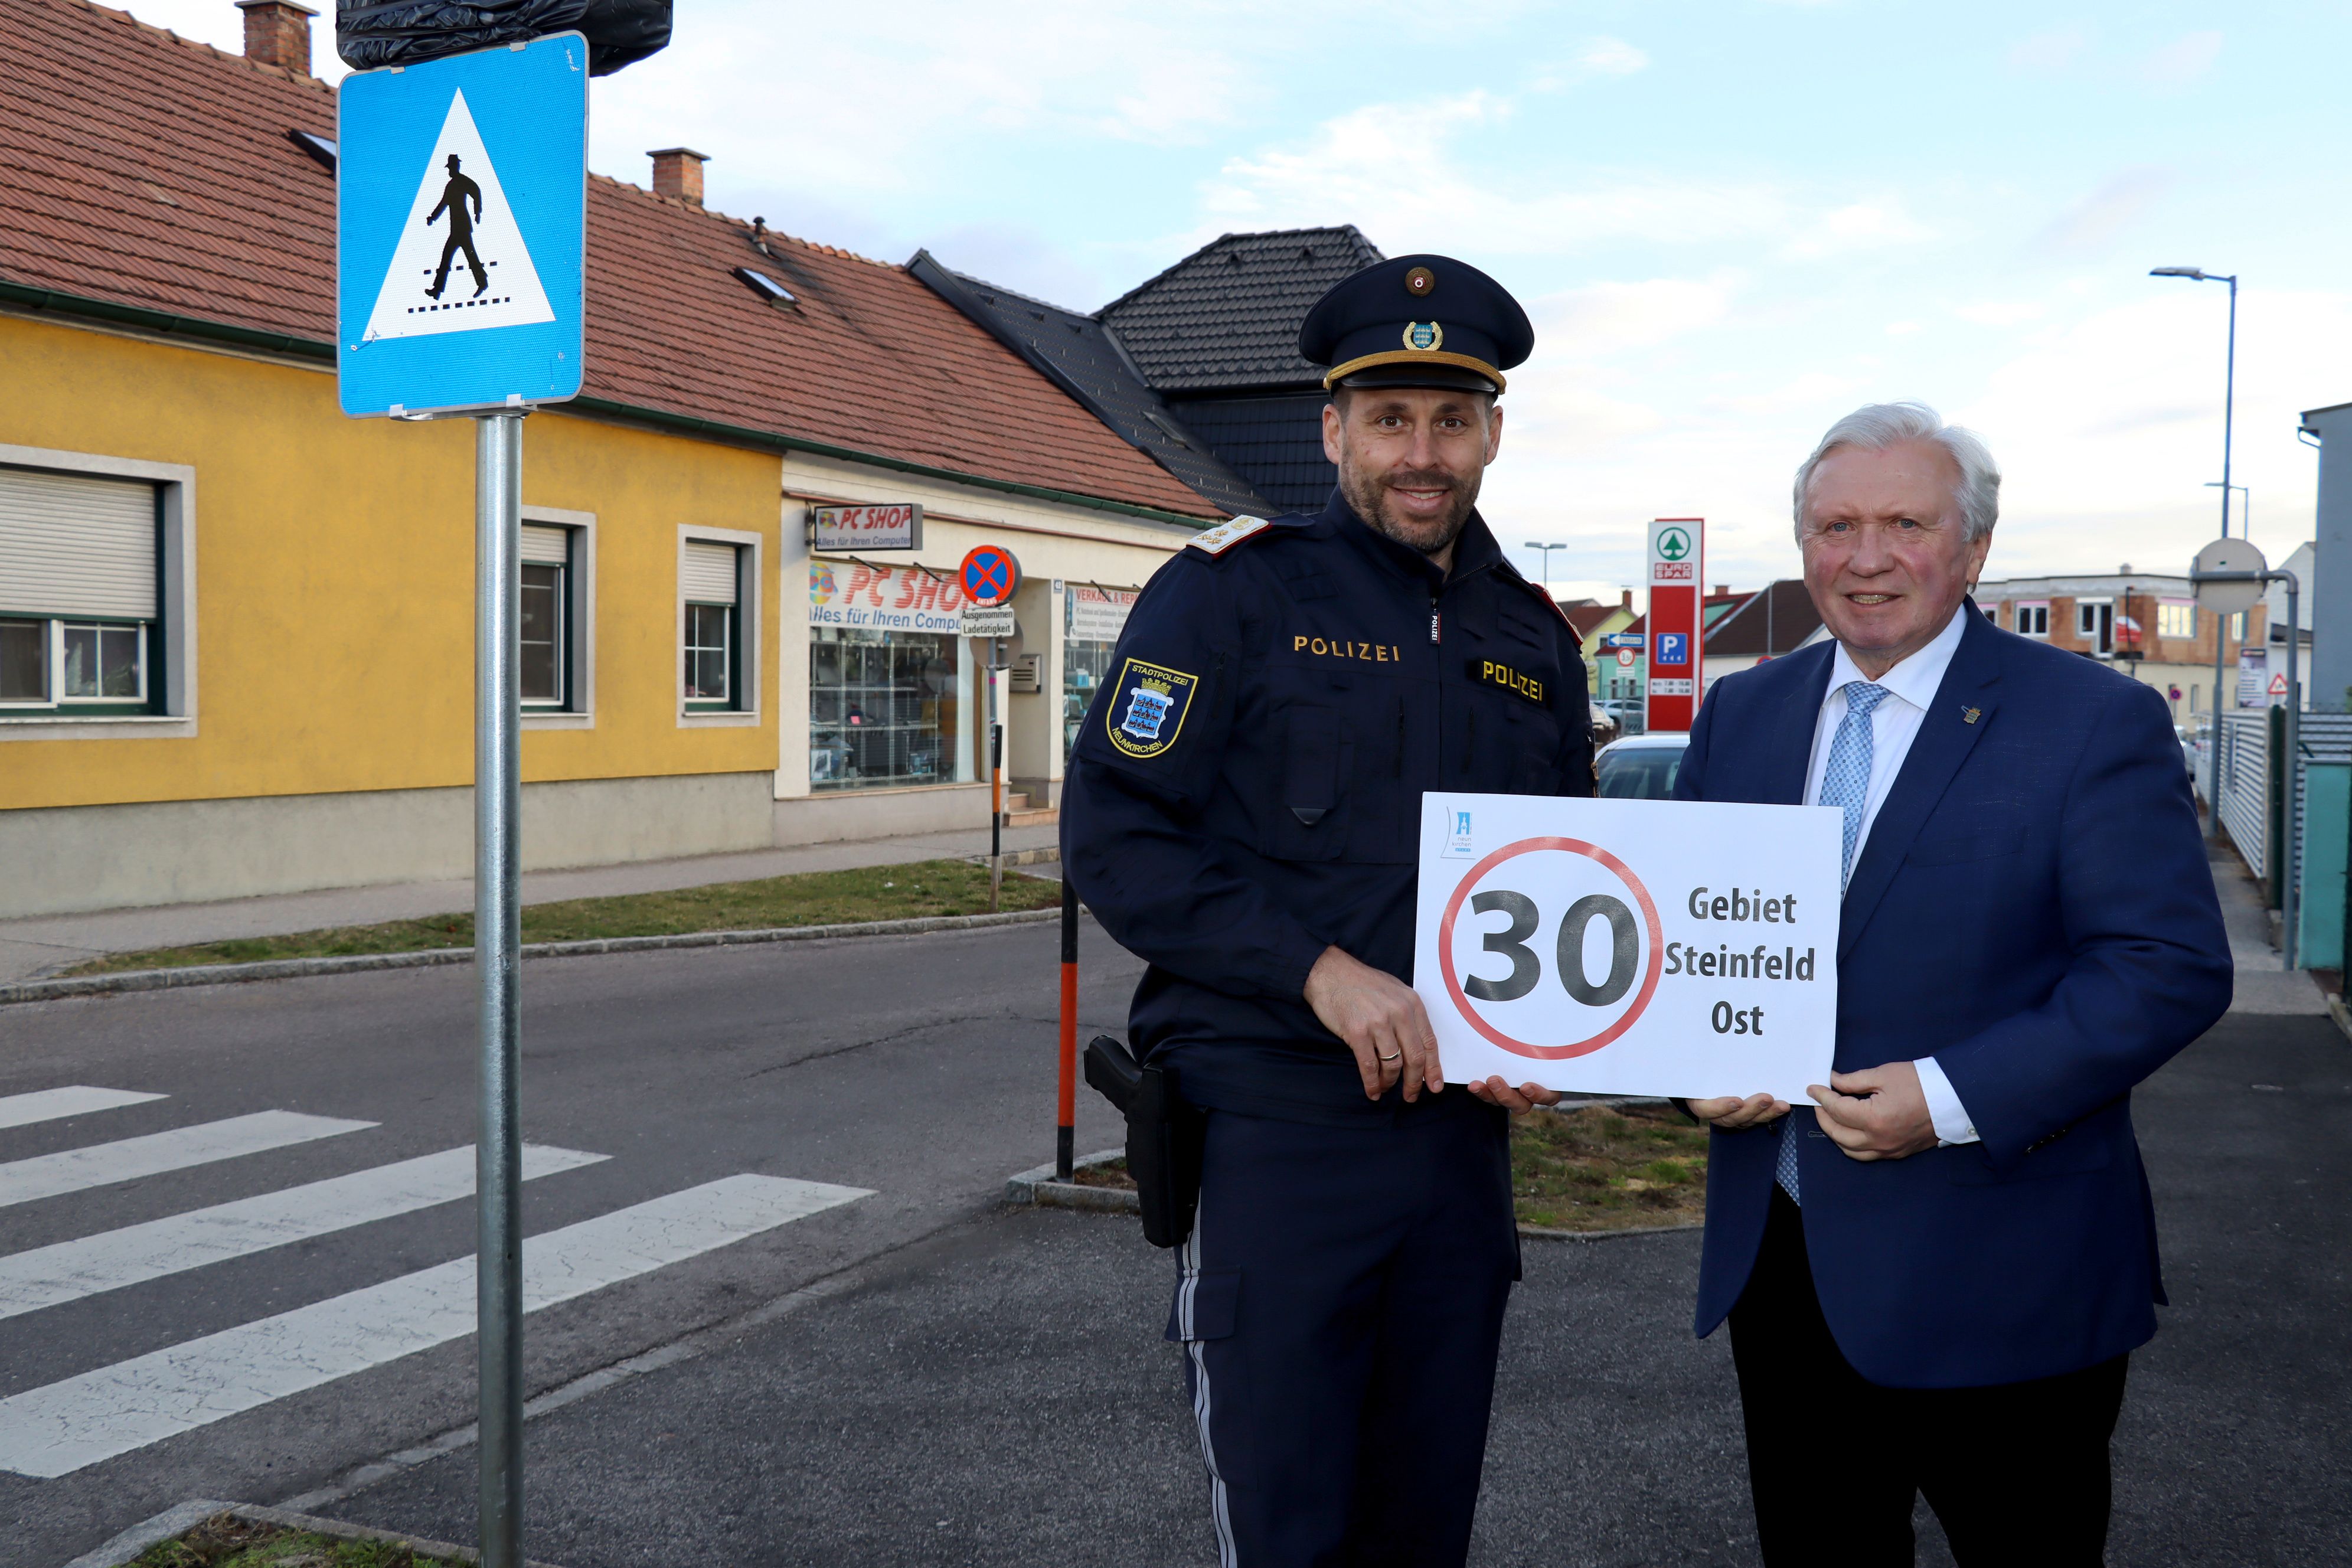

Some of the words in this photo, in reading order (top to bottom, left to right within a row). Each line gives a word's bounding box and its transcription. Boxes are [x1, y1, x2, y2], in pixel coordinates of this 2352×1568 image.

[839, 509, 862, 530] PC
[864, 507, 911, 530] SHOP
[816, 538, 835, 546] Alles
[838, 537, 848, 545] für
[851, 537, 870, 545] Ihren
[873, 536, 911, 546] Computer
[843, 564, 892, 607] PC
[893, 569, 968, 612] SHO
[1054, 581, 1061, 589] 42
[1114, 592, 1119, 603] &
[847, 608, 868, 624] für
[873, 610, 910, 626] Ihren
[961, 610, 1012, 621] Ausgenommen
[963, 623, 1010, 635] Ladetätigkeit
[1294, 635, 1400, 662] POLIZEI
[1664, 636, 1678, 654] P
[1132, 665, 1189, 686] STADTPOLIZEI
[1483, 661, 1543, 702] POLIZEI
[1112, 727, 1163, 753] NEUNKIRCHEN
[1688, 887, 1797, 924] Gebiet
[1464, 890, 1639, 1007] 30
[1665, 942, 1815, 981] Steinfeld
[1711, 1001, 1764, 1035] Ost
